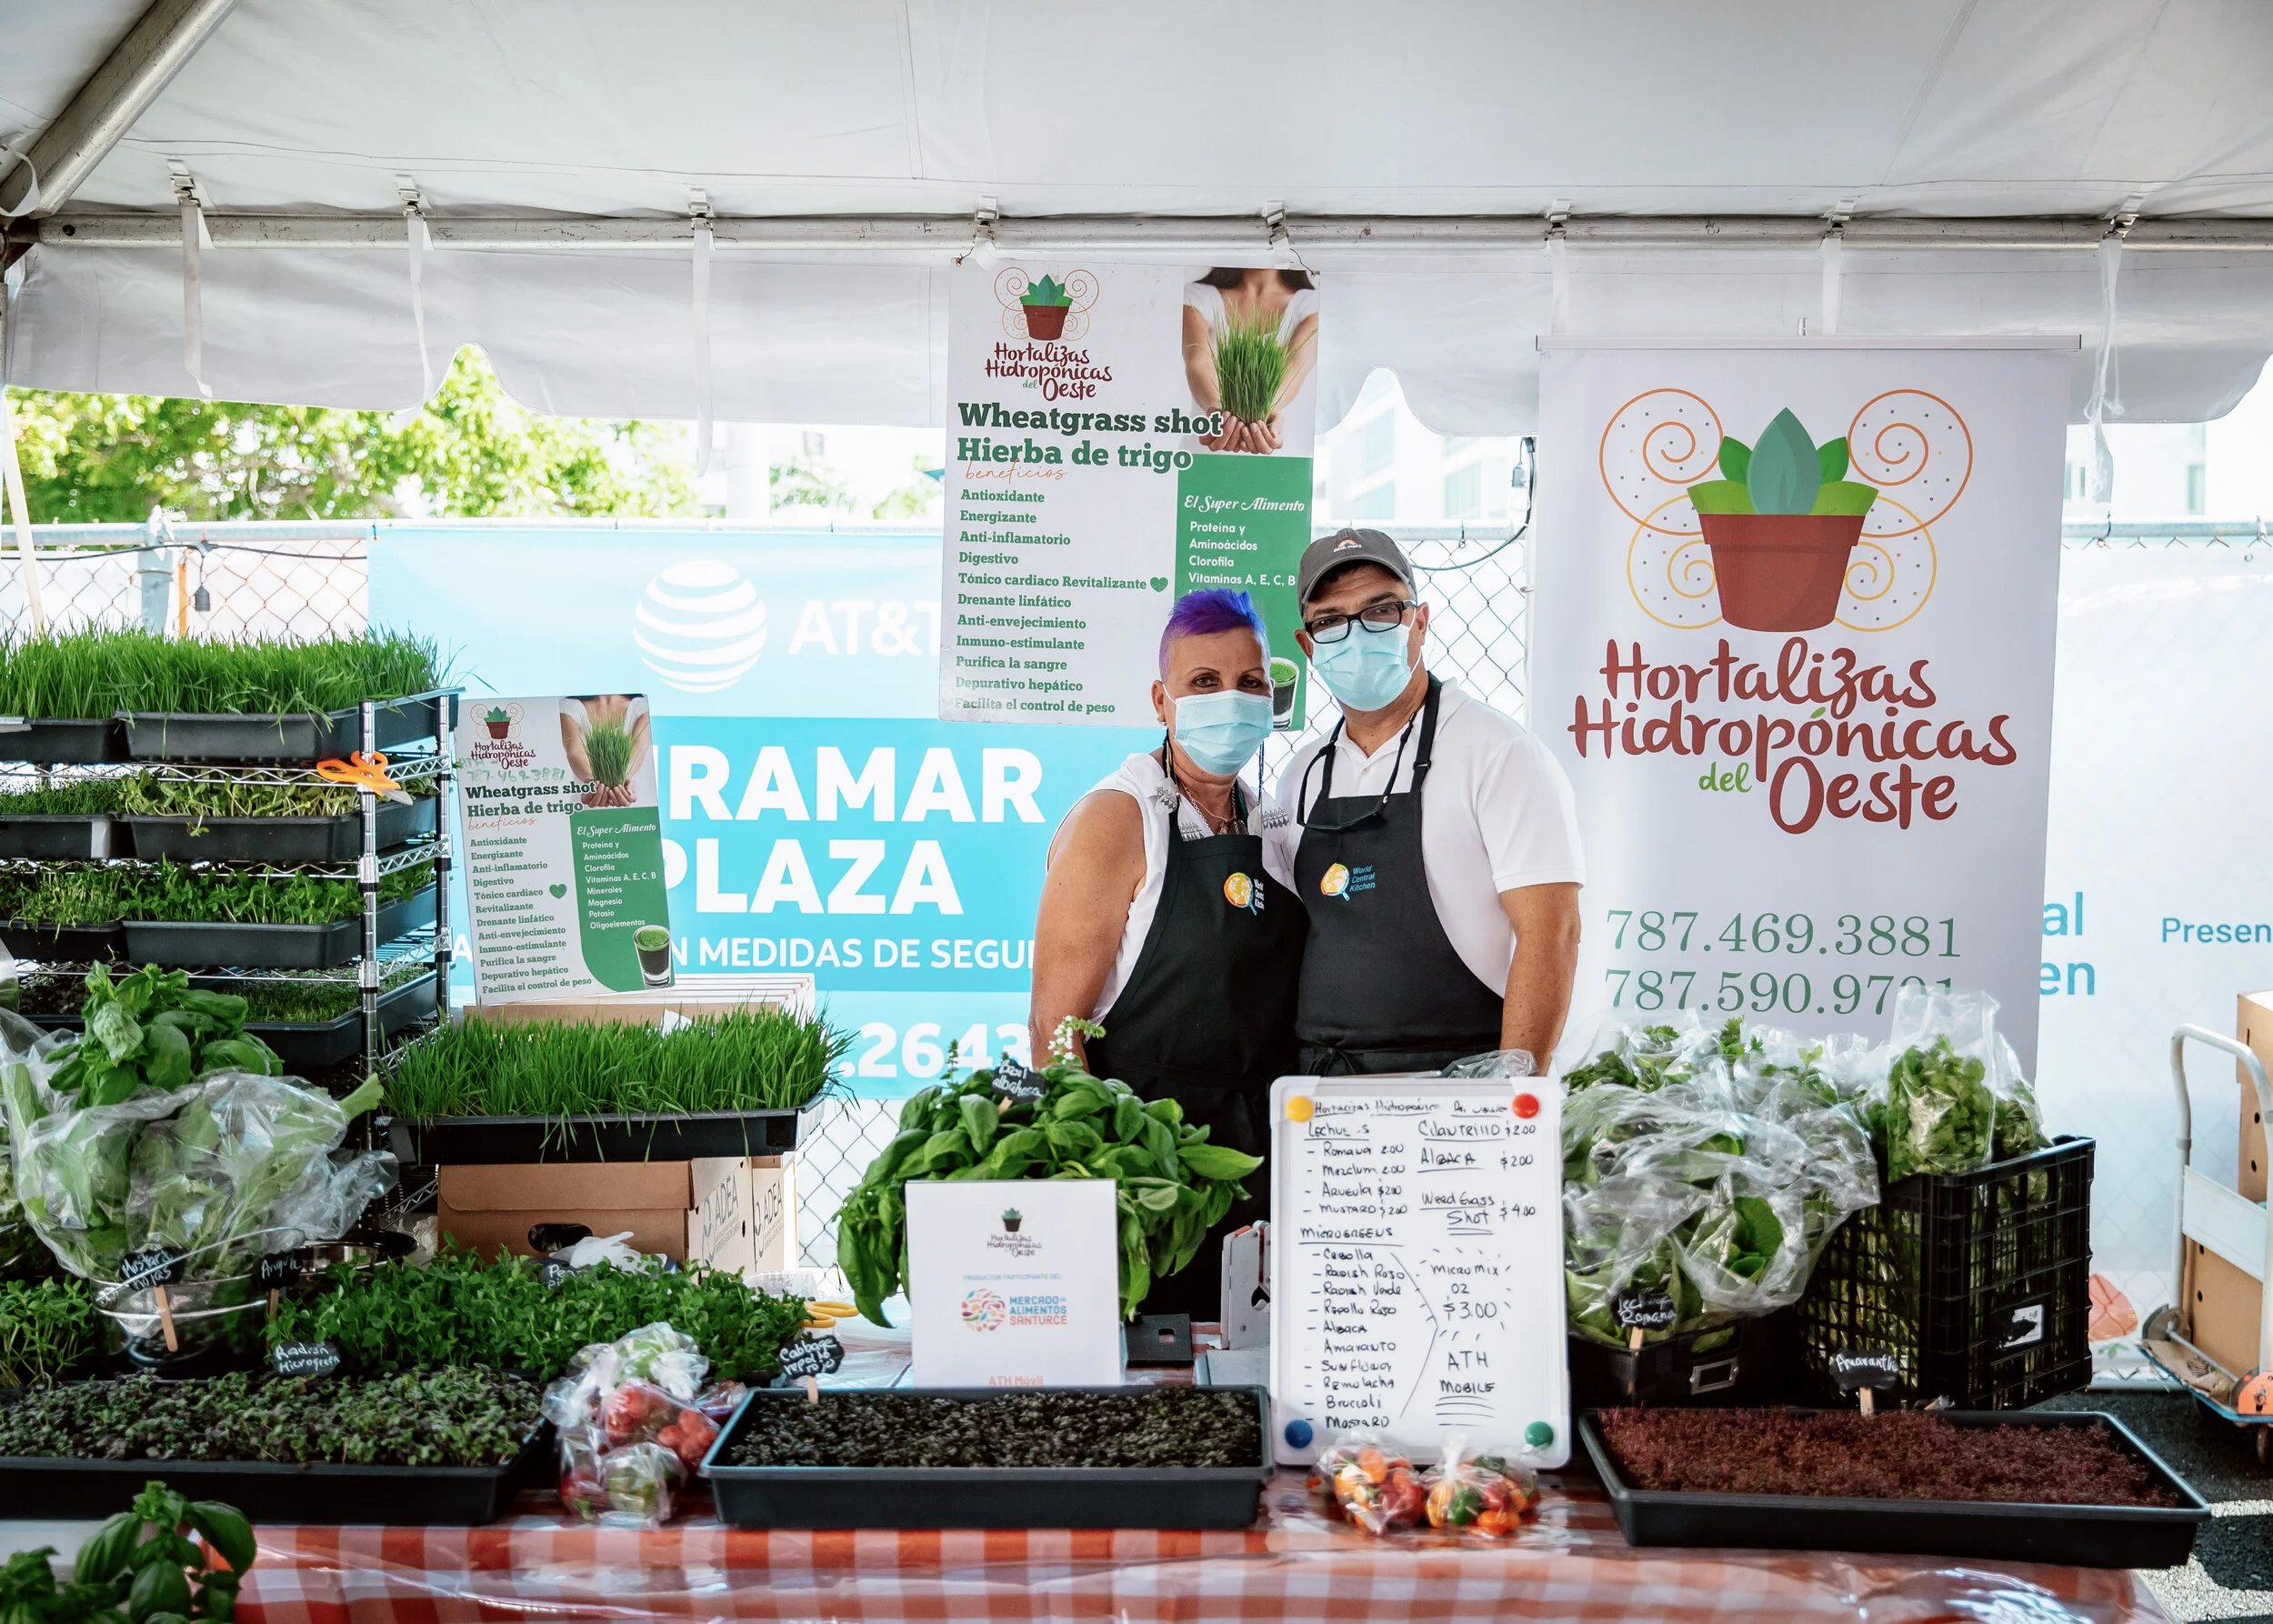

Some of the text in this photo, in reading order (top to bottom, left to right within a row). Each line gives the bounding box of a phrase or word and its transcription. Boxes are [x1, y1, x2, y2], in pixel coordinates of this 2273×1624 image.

[995, 341, 1090, 365] Hortalizas
[985, 360, 1113, 386] Hidropónicas
[1023, 378, 1096, 401] del Oeste
[958, 403, 1222, 436] Wheatgrass shot
[957, 438, 1192, 474] Hierba de trigo
[965, 459, 1067, 485] beneficios
[960, 489, 1045, 503] Antioxidante
[1185, 496, 1306, 513] El Super Alimento
[960, 510, 1036, 525] Energizante
[1189, 521, 1246, 536] Proteína y
[959, 531, 1071, 546] Anti-inflamatorio
[1189, 538, 1257, 551] Aminoácidos
[958, 552, 1018, 566] Digestivo
[1188, 556, 1235, 568] Clorofila
[958, 573, 1147, 590] Tónico cardiaco Revitalizante
[1188, 572, 1296, 586] Vitaminas A, E, C, B
[957, 594, 1072, 608] Drenante linfático
[956, 615, 1086, 630] Anti-envejecimiento
[956, 636, 1085, 650] Inmuno-estimulante
[956, 657, 1067, 671] Purifica la sangre
[1599, 637, 1937, 717] Hortalizas
[956, 677, 1083, 693] Depurativo hepático
[955, 697, 1116, 716] Facilita el control de peso
[475, 740, 524, 752] Hortalizas
[1567, 695, 2018, 783] Hidropónicas
[471, 749, 536, 762] Hidropónicas
[501, 757, 529, 769] Oeste
[466, 781, 596, 799] Wheatgrass shot
[652, 744, 1046, 823] RAMAR
[1698, 756, 1958, 835] del Oeste
[467, 800, 584, 817] Hierba de trigo
[468, 816, 536, 831] beneficios
[577, 823, 656, 838] El Super Alimento
[470, 837, 527, 847] Antioxidante
[471, 850, 524, 860] Energizante
[584, 852, 629, 861] Aminoácidos
[473, 861, 547, 874] Anti-inflamatorio
[585, 864, 616, 872] Clorofila
[1352, 865, 1373, 875] World
[473, 877, 515, 887] Digestivo
[586, 875, 621, 883] Vitaminas
[1351, 872, 1376, 884] Central
[586, 887, 623, 895] Minerales
[1349, 882, 1376, 892] Kitchen
[474, 889, 544, 900] Tónico cardiaco
[476, 903, 534, 914] Revitalizante
[588, 897, 623, 907] Magnesio
[476, 915, 555, 927] Drenante linfático
[589, 910, 615, 918] Potasio
[590, 919, 646, 929] Oligoelementos
[478, 927, 566, 940] Anti-envejecimiento
[1607, 909, 1961, 957] 787.469.3881
[478, 940, 566, 954] Inmuno-estimulante
[700, 937, 863, 968] MEDIDAS
[874, 939, 919, 968] DE
[930, 939, 1034, 969] SEGU
[480, 955, 556, 967] Purifica la sangre
[481, 967, 569, 981] Depurativo hepático
[482, 977, 592, 995] Facilita el control de peso
[715, 1173, 783, 1231] ADEA ADEA
[1012, 1248, 1035, 1258] Oeste
[1009, 1296, 1059, 1306] MERCADO
[1009, 1305, 1067, 1315] ALIMENTOS
[1009, 1315, 1067, 1326] SANTURCE
[1447, 1351, 1489, 1371] ATH
[989, 1376, 1012, 1387] ATH
